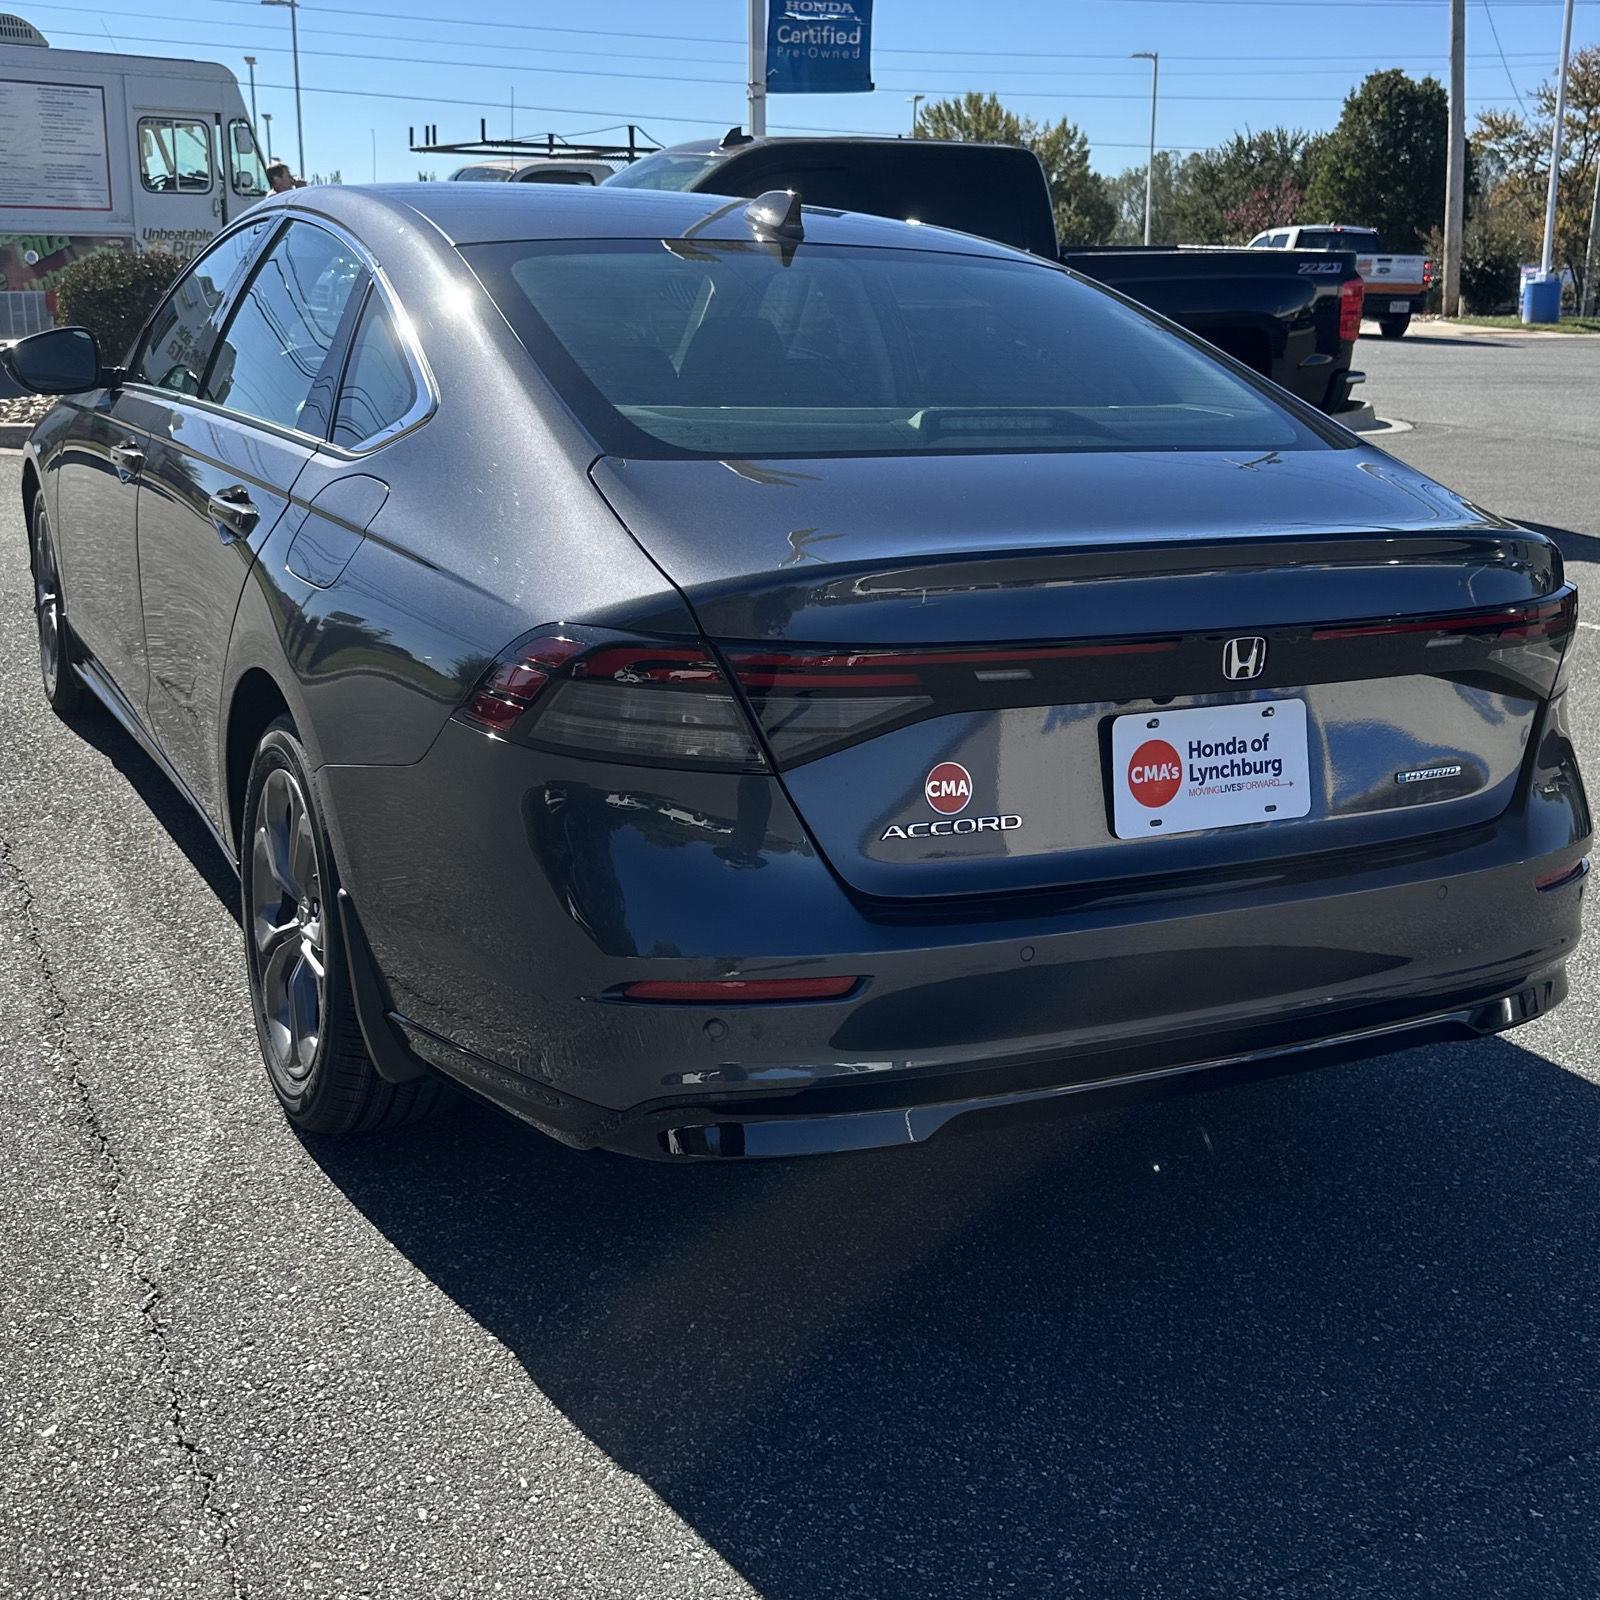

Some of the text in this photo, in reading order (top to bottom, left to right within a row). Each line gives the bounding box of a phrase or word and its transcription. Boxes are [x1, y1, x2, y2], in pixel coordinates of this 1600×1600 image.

[785, 1, 855, 13] HONDA
[777, 25, 861, 44] Certified
[777, 46, 860, 59] Pre-Owned
[142, 227, 213, 241] Unbeatable
[1188, 733, 1270, 759] Honda of
[1131, 762, 1180, 784] CMA's
[1189, 758, 1282, 786] Lynchburg
[1407, 767, 1457, 780] HYBRID
[927, 780, 969, 797] CMA
[881, 814, 1023, 841] ACCORD
